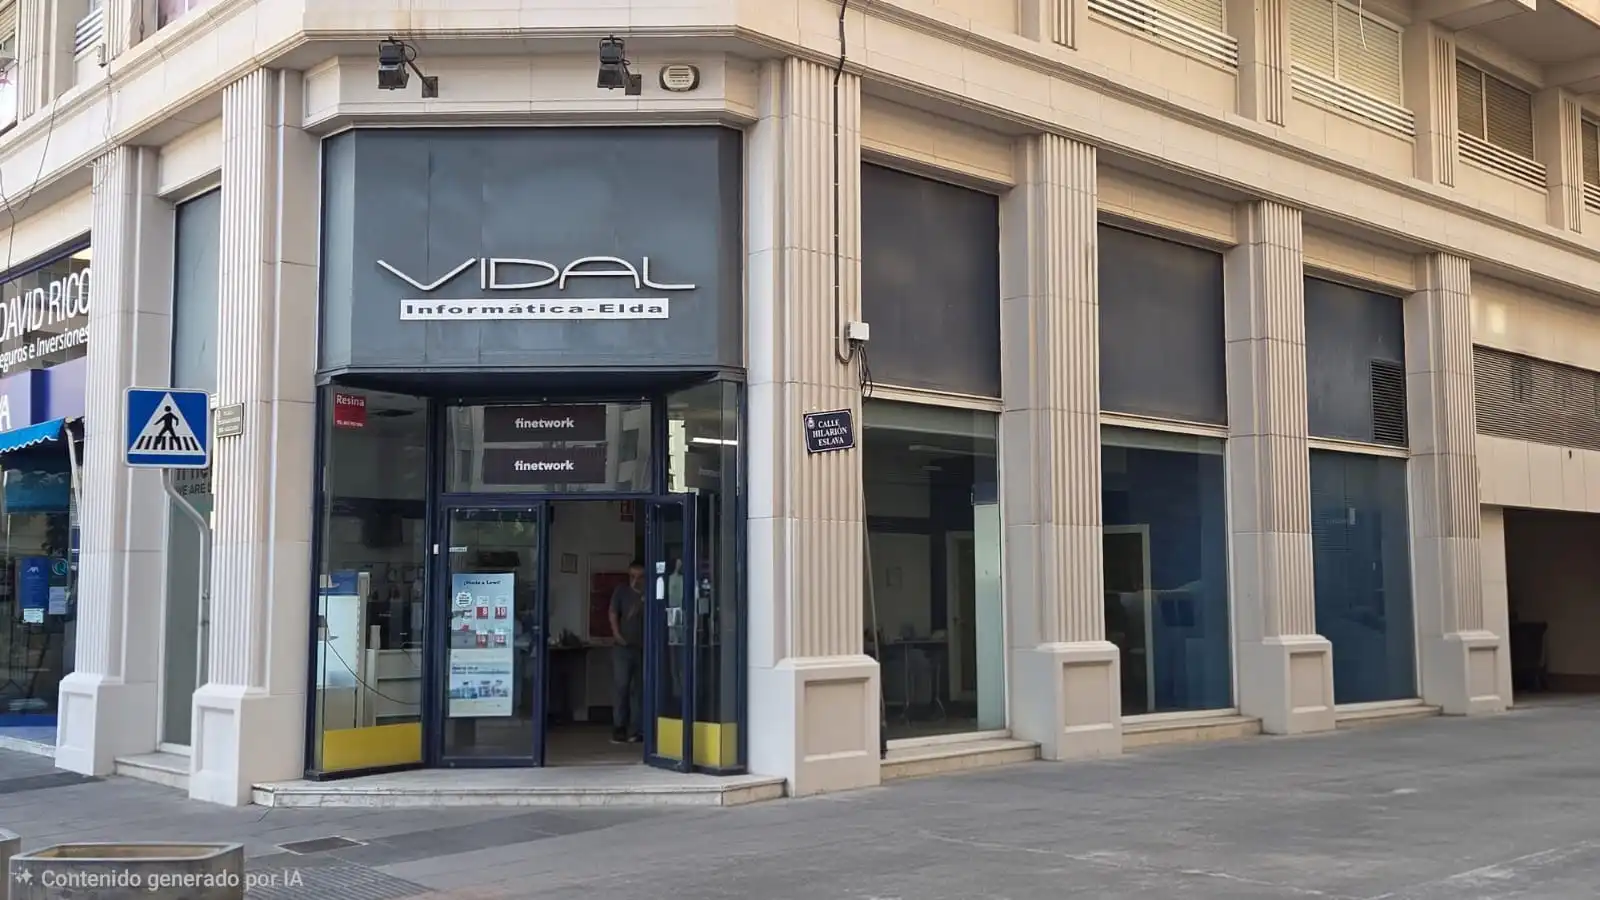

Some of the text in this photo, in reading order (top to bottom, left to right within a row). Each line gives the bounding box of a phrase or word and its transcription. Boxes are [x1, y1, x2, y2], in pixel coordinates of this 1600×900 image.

[377, 256, 696, 291] VIDAL
[48, 267, 91, 325] RICO
[406, 303, 664, 316] Informática-Elda
[29, 343, 36, 359] e
[336, 394, 365, 406] Resina
[514, 417, 575, 428] finetwork
[818, 419, 840, 428] CALLE
[818, 437, 844, 446] ESLAVA
[514, 460, 575, 471] finetwork
